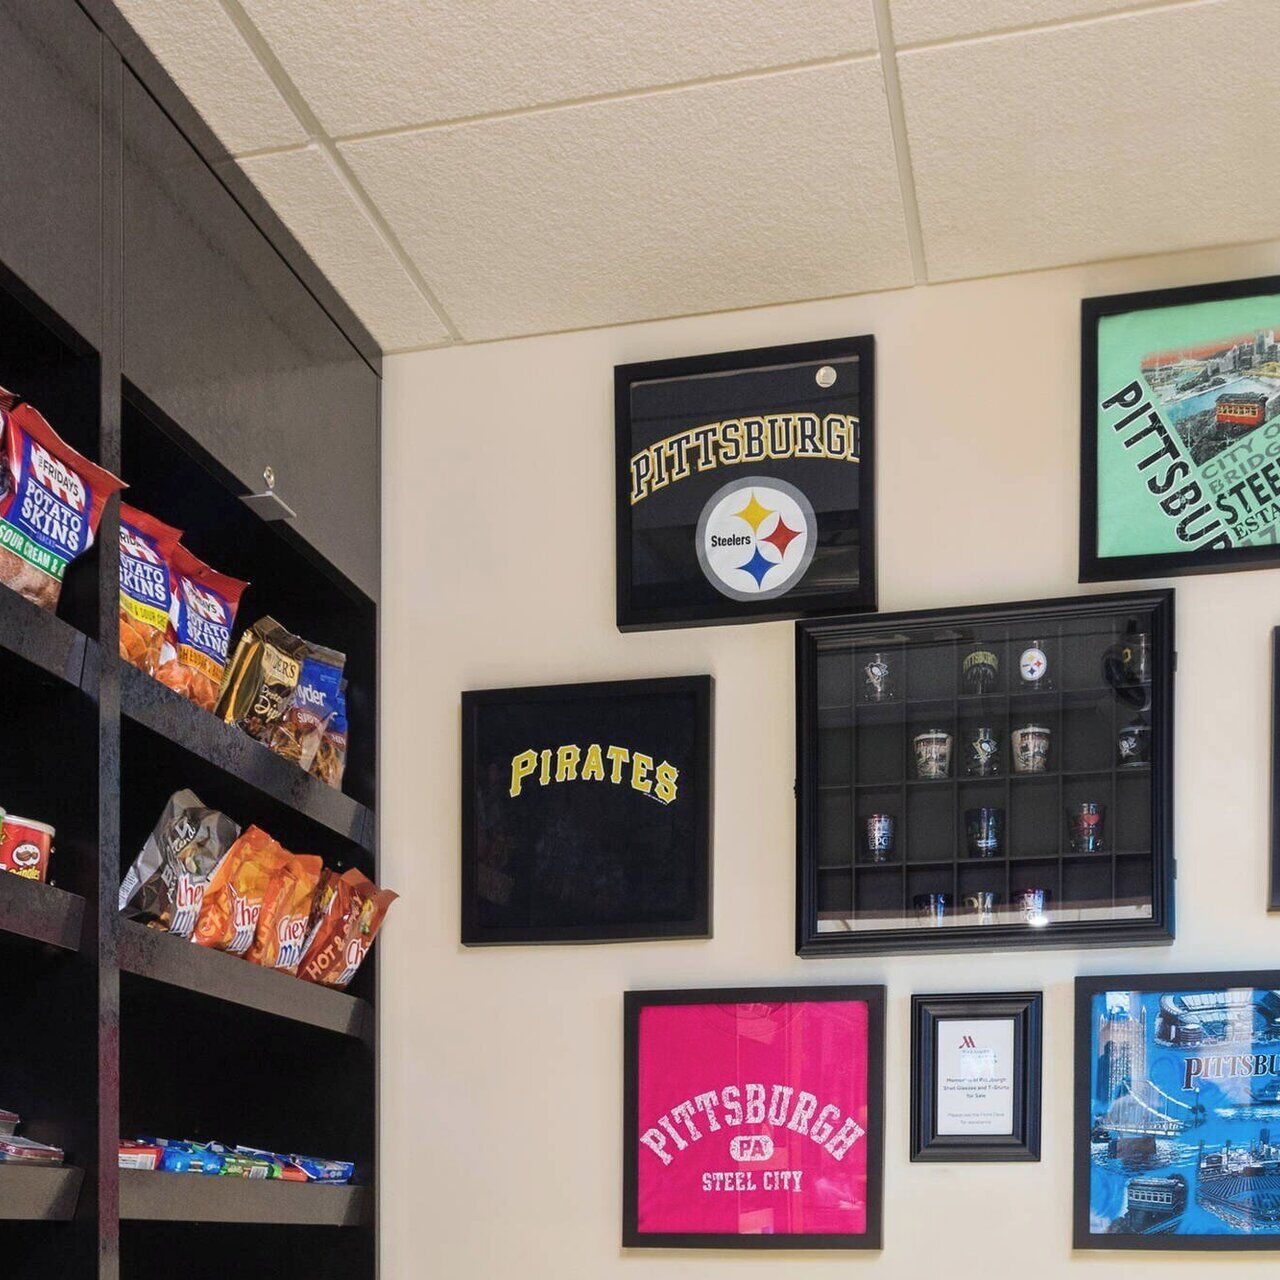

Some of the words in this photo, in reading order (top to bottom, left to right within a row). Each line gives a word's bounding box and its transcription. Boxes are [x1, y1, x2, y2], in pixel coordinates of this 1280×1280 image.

[1200, 437, 1258, 481] CITY
[43, 459, 79, 497] FRIDAYS
[21, 496, 79, 551] SKINS
[25, 480, 81, 533] POTATO
[23, 540, 51, 569] CREAM
[710, 533, 752, 550] Steelers
[509, 743, 679, 804] PIRATES
[234, 898, 262, 928] Che
[277, 914, 309, 944] Chex
[305, 943, 336, 980] HOT
[639, 1082, 866, 1167] PITTSBURGH
[738, 1139, 766, 1158] PA
[702, 1170, 757, 1192] STEEL
[763, 1169, 804, 1193] CITY
